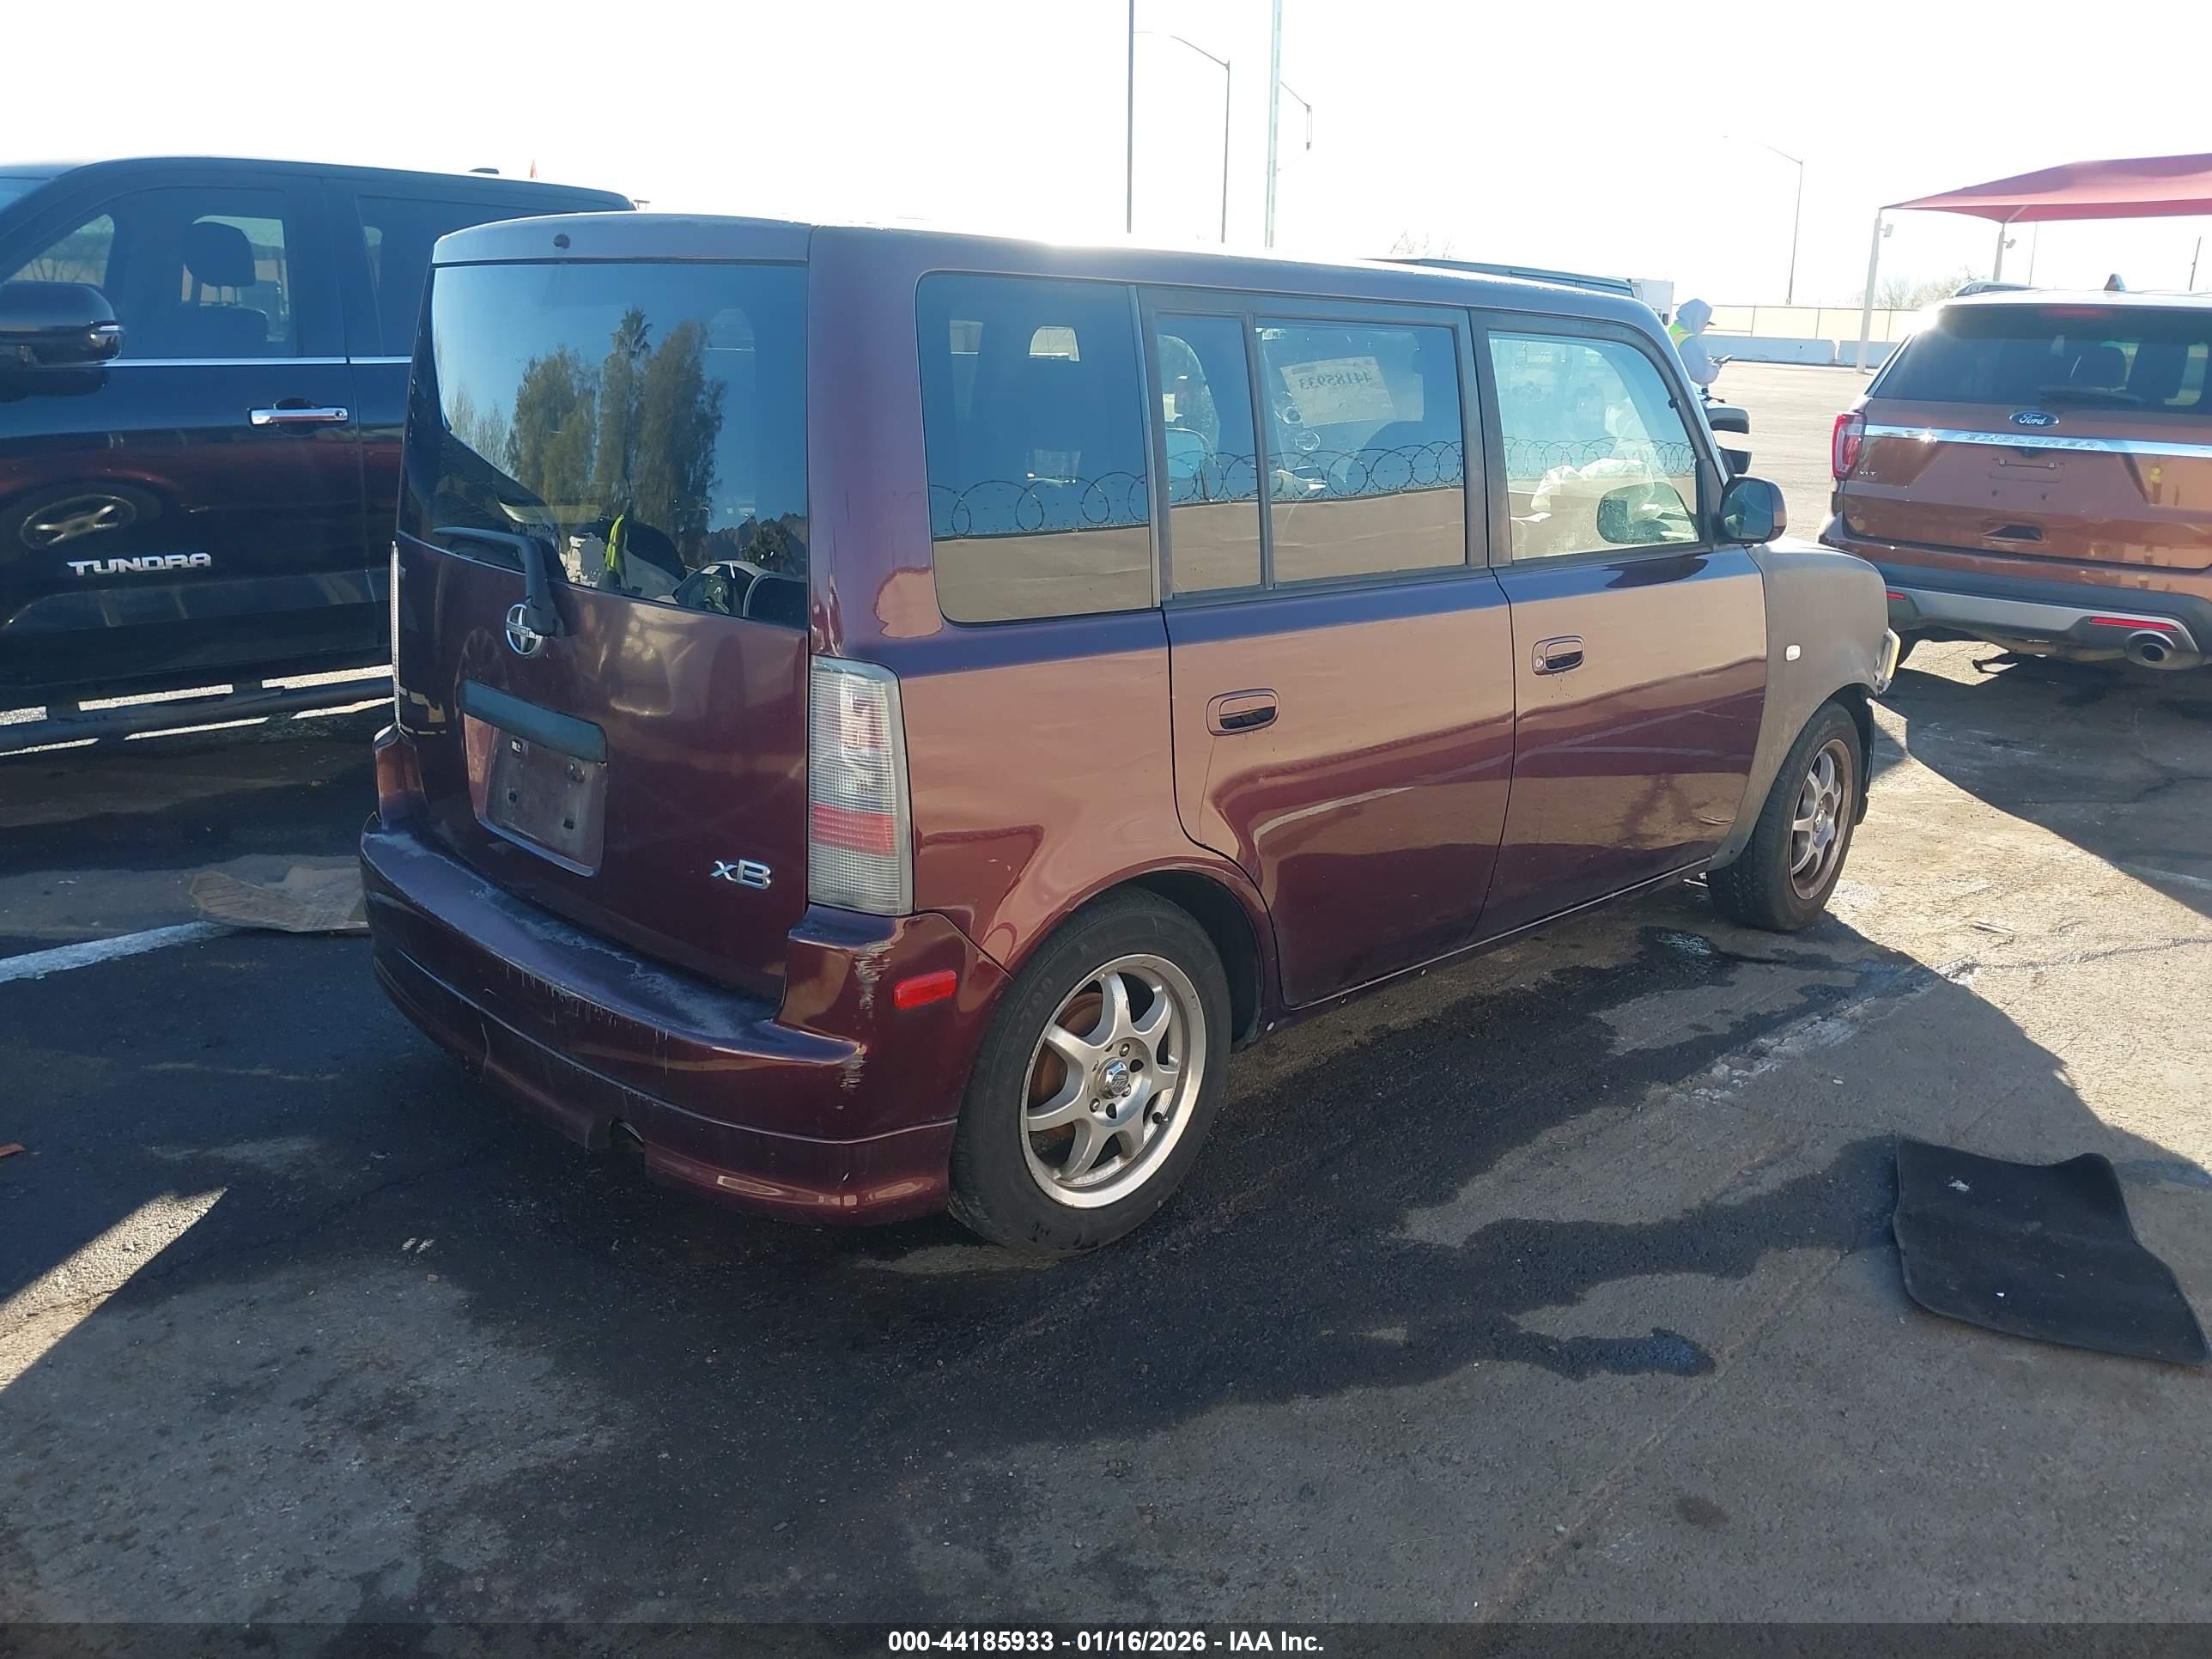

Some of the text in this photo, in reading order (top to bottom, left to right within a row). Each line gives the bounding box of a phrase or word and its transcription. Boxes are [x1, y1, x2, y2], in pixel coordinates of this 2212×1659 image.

[2019, 412, 2047, 426] Ford
[66, 552, 212, 576] TUNDRA
[709, 859, 772, 890] xB
